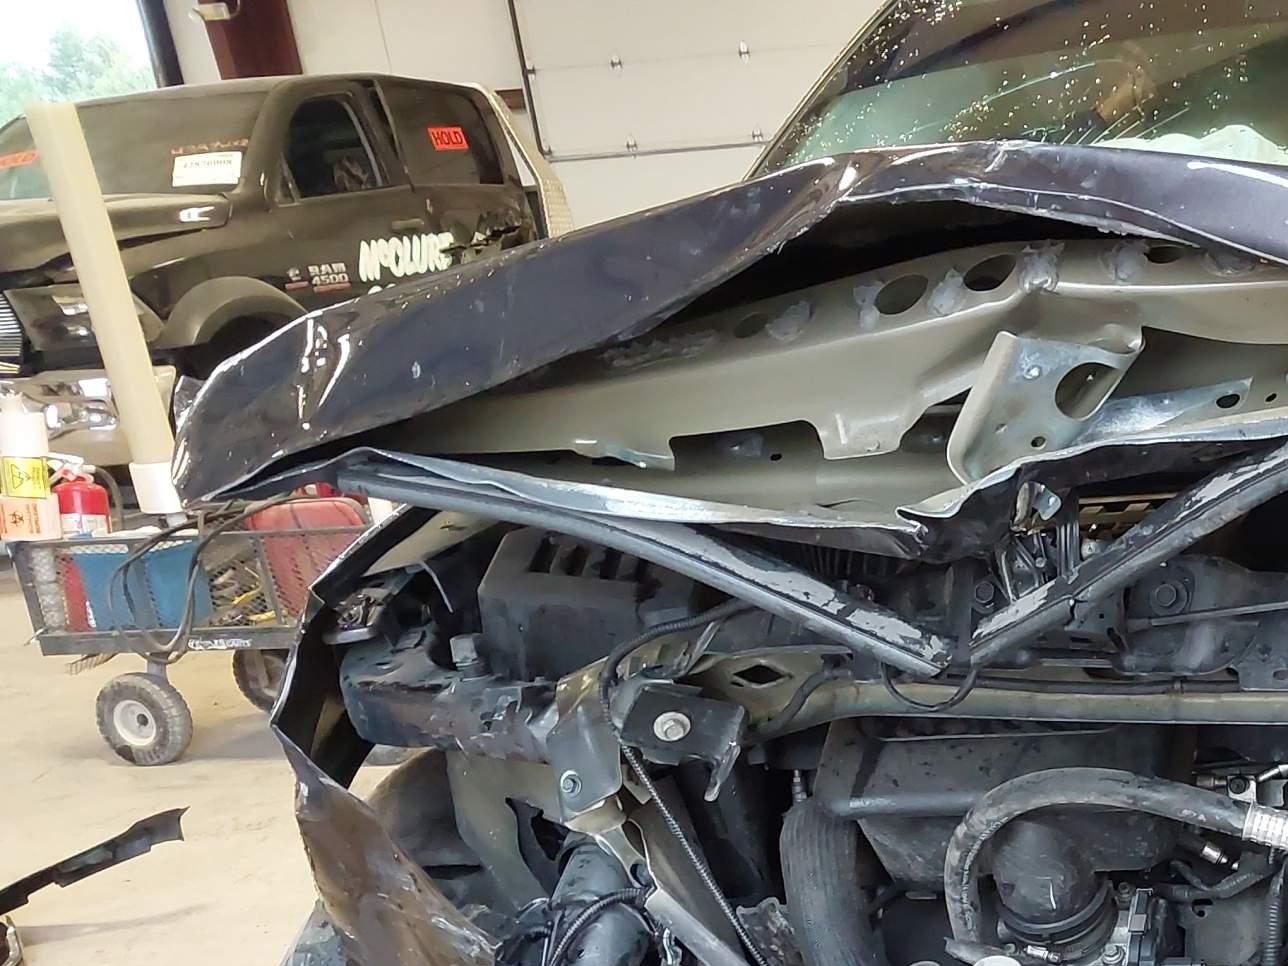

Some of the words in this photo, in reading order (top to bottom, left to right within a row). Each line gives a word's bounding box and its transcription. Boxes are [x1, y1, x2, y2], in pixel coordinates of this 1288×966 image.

[431, 129, 464, 146] HOLD
[308, 263, 346, 276] RAM
[312, 273, 349, 286] 4500
